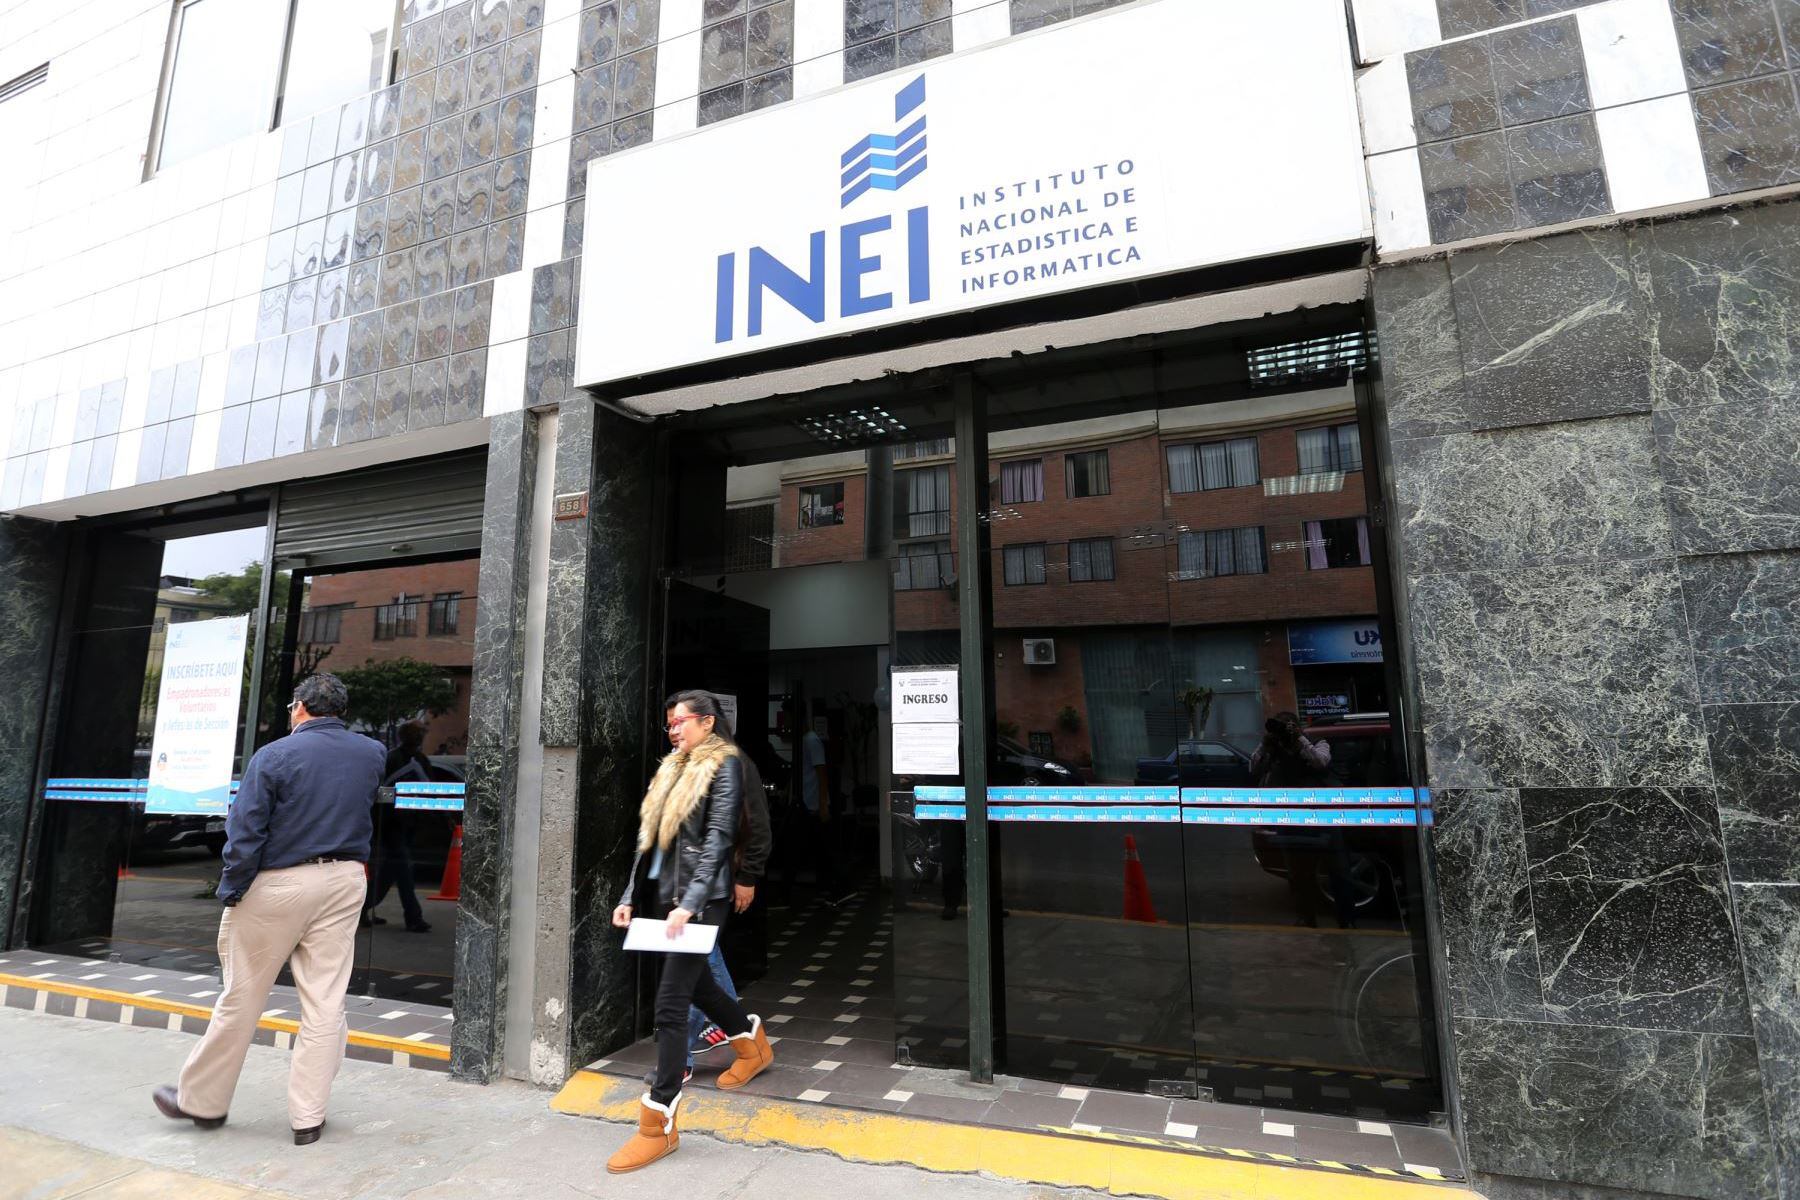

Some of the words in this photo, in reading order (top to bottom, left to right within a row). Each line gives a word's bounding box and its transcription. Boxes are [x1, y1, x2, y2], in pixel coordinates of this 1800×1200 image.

[959, 159, 1135, 210] INSTITUTO
[960, 202, 1089, 238] NACIONAL
[1103, 187, 1137, 209] DE
[961, 221, 1114, 266] ESTADISTICA
[1126, 216, 1139, 233] E
[715, 205, 931, 344] INEI
[962, 245, 1141, 294] INFORMATICA
[903, 693, 948, 704] INGRESO
